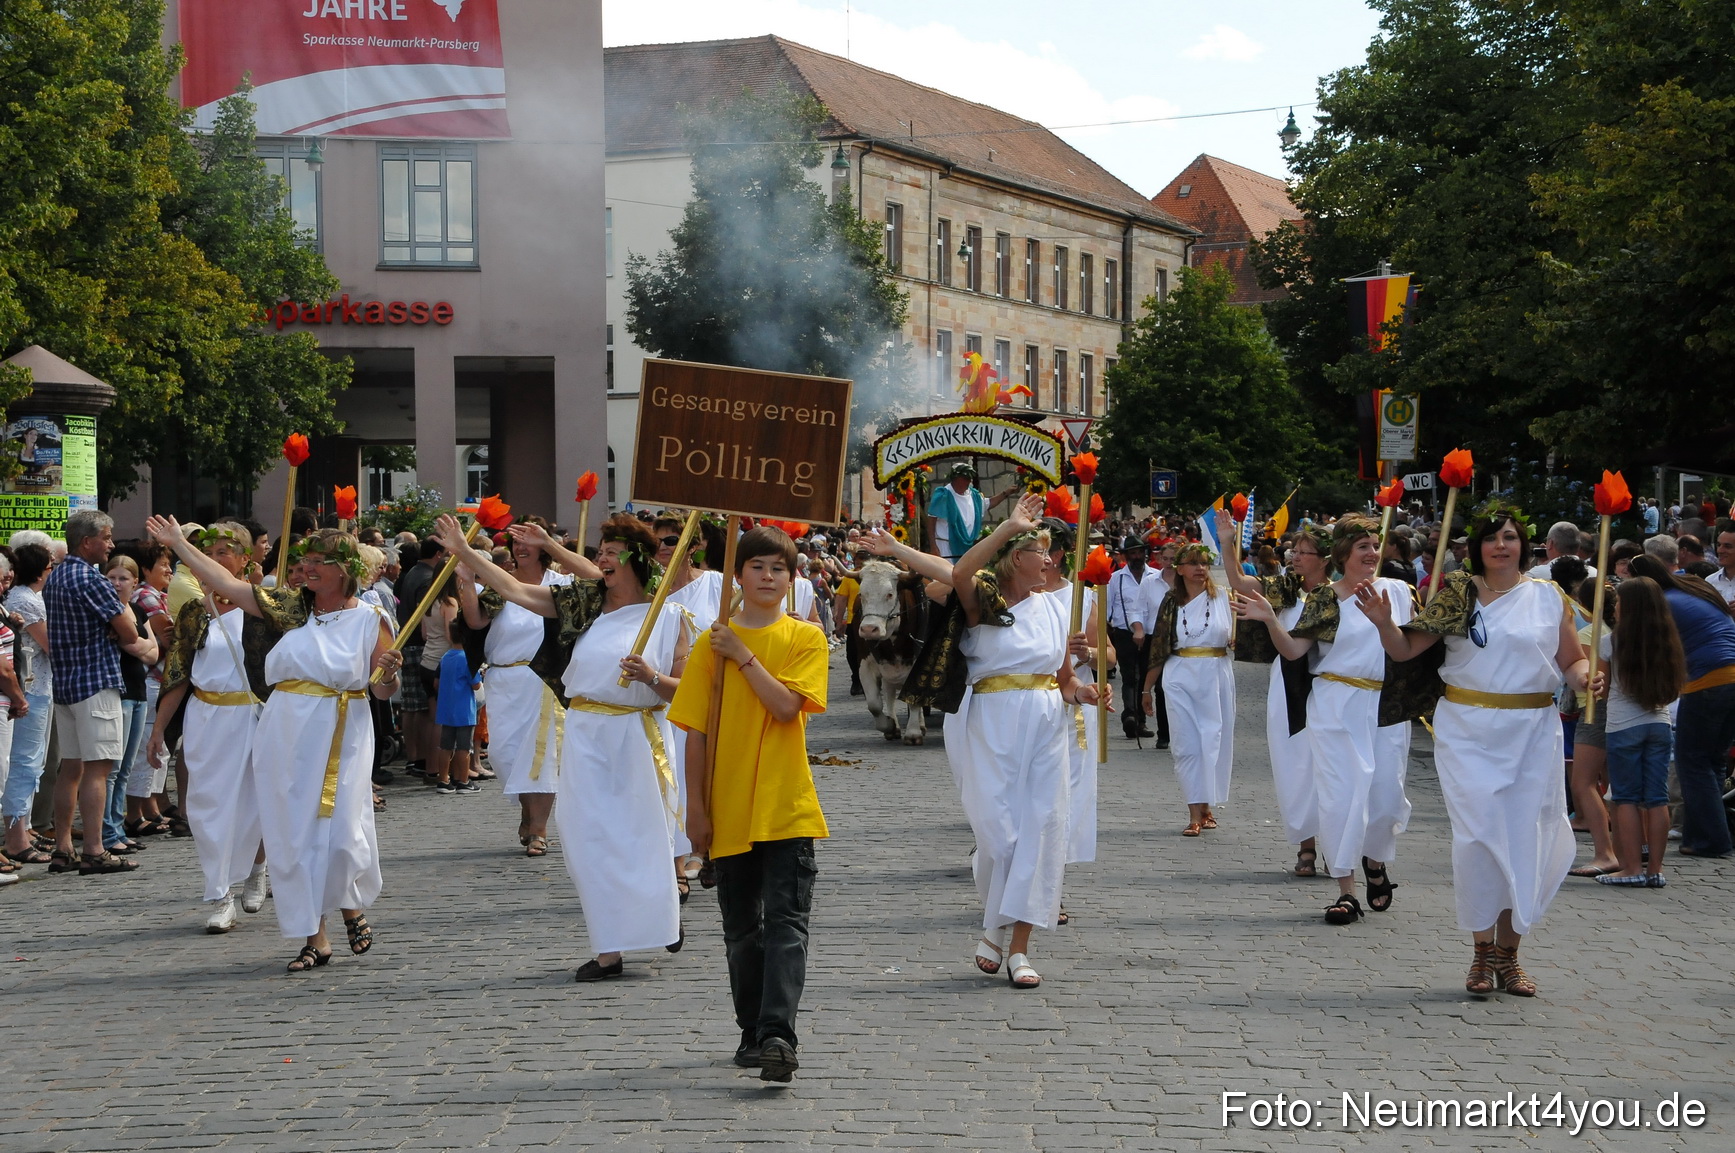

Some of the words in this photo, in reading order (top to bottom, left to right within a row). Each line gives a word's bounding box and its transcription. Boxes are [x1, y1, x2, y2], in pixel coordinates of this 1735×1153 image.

[302, 0, 408, 21] JAHRE
[302, 33, 365, 47] Sparkasse
[368, 36, 480, 53] Neumarkt-Parsberg
[652, 386, 836, 427] Gesangverein
[885, 424, 994, 465] GESANGVEREIN
[655, 435, 817, 498] Pölling
[1410, 475, 1429, 488] WC
[15, 497, 45, 507] Berlin
[48, 498, 68, 507] Club
[0, 508, 68, 519] OLKSFEST
